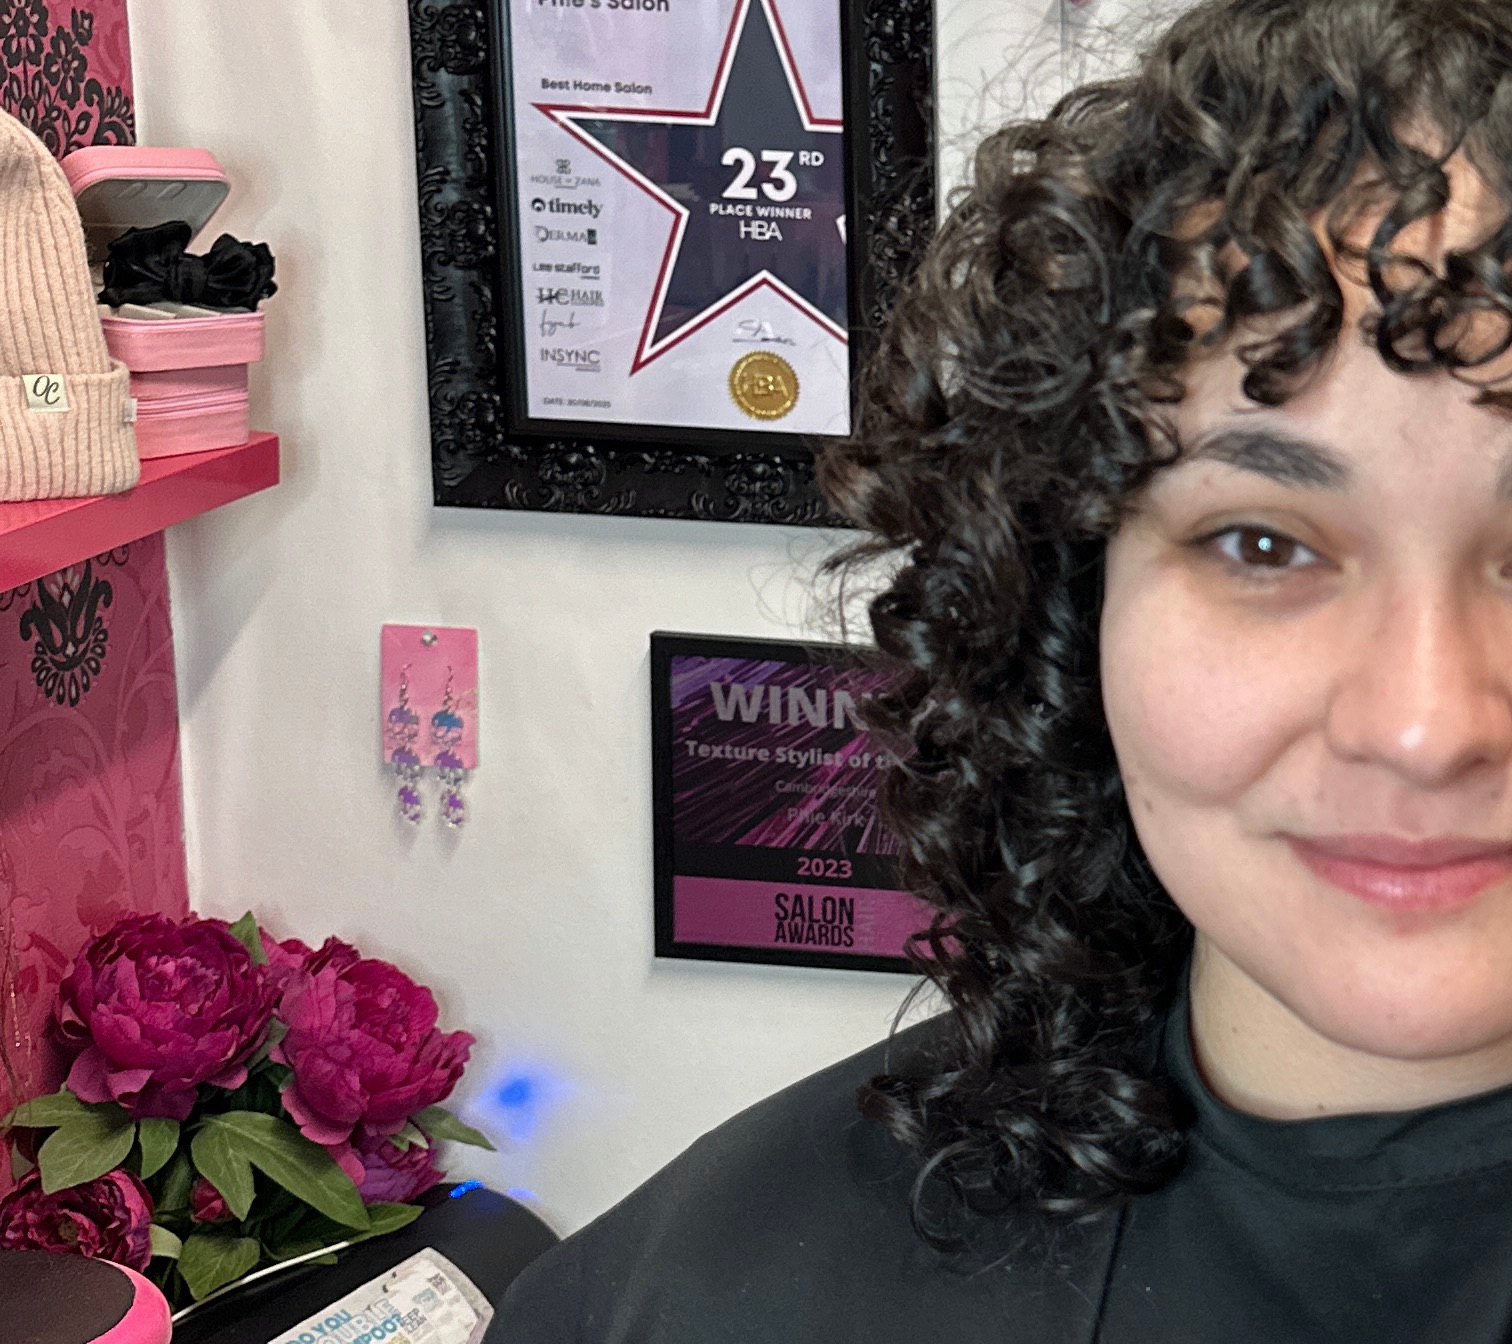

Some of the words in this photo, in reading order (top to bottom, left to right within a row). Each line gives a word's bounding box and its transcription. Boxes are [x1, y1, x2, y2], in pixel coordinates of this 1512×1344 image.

[541, 78, 570, 90] Best
[573, 79, 612, 93] Home
[614, 82, 653, 95] Salon
[548, 197, 604, 219] timely
[709, 203, 753, 216] PLACE
[755, 205, 812, 220] WINNER
[739, 219, 783, 241] HBA
[540, 348, 601, 364] INSYNC
[685, 740, 769, 762] Texture
[775, 745, 842, 769] Stylist
[848, 750, 870, 769] of
[797, 856, 854, 878] 2023
[774, 892, 855, 925] SALON
[774, 921, 855, 947] AWARDS
[311, 1309, 353, 1335] YOU
